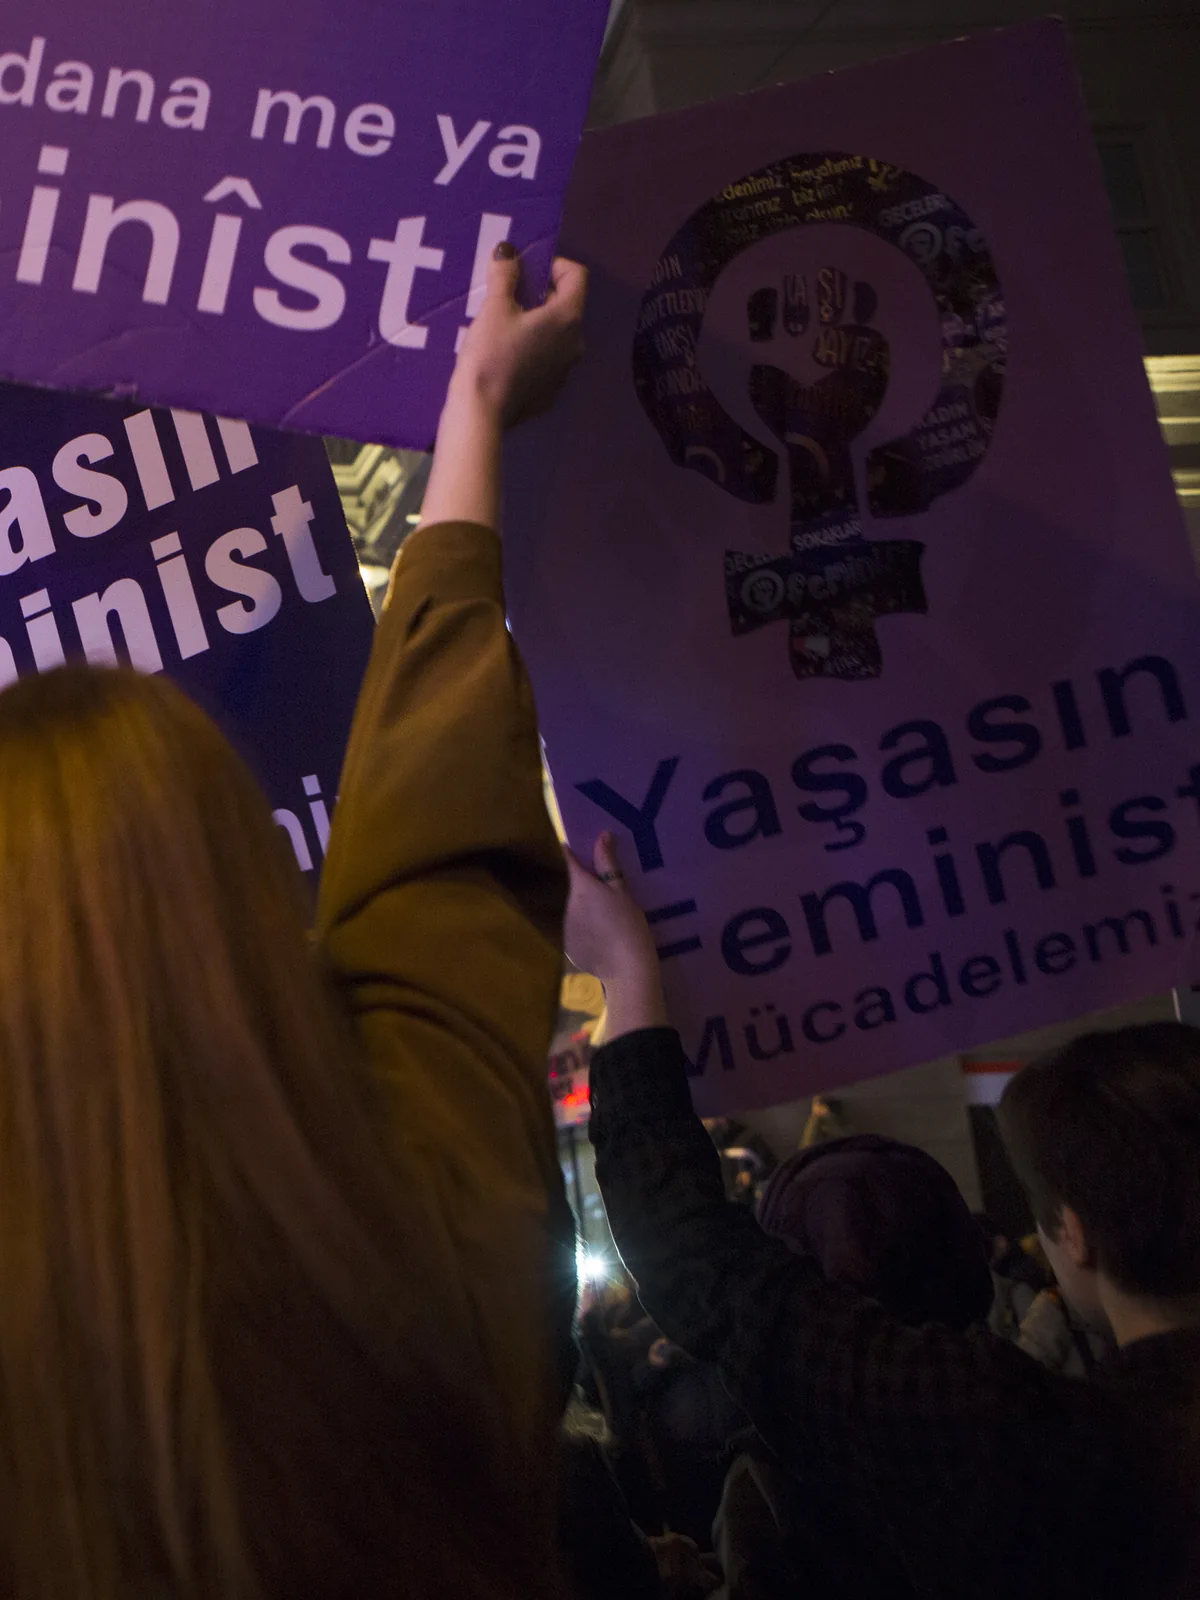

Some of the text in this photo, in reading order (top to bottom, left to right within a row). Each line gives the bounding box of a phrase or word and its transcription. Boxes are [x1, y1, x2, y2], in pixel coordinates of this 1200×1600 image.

[250, 86, 397, 157] me
[433, 113, 543, 186] ya
[575, 655, 1187, 872] Yaşasın
[682, 884, 1200, 1079] Mücadelemi
